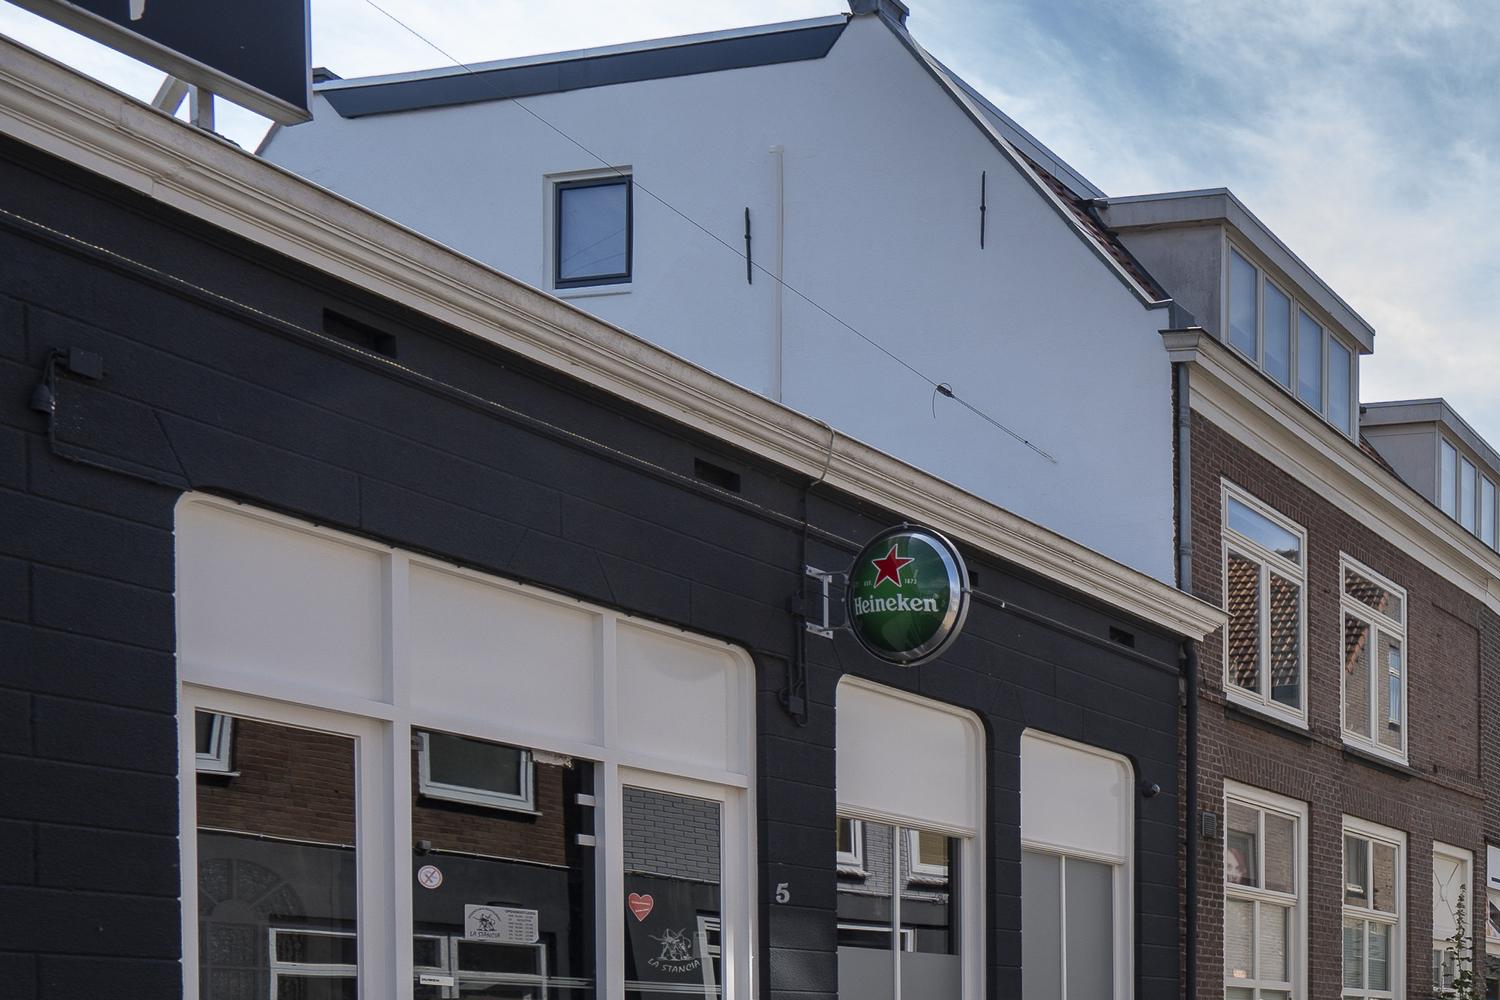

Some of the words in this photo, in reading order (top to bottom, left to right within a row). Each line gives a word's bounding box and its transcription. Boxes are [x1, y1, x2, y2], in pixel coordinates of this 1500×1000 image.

[854, 593, 940, 616] Heineken
[775, 882, 790, 904] 5
[647, 958, 660, 968] LA
[661, 959, 701, 973] STANCIA
